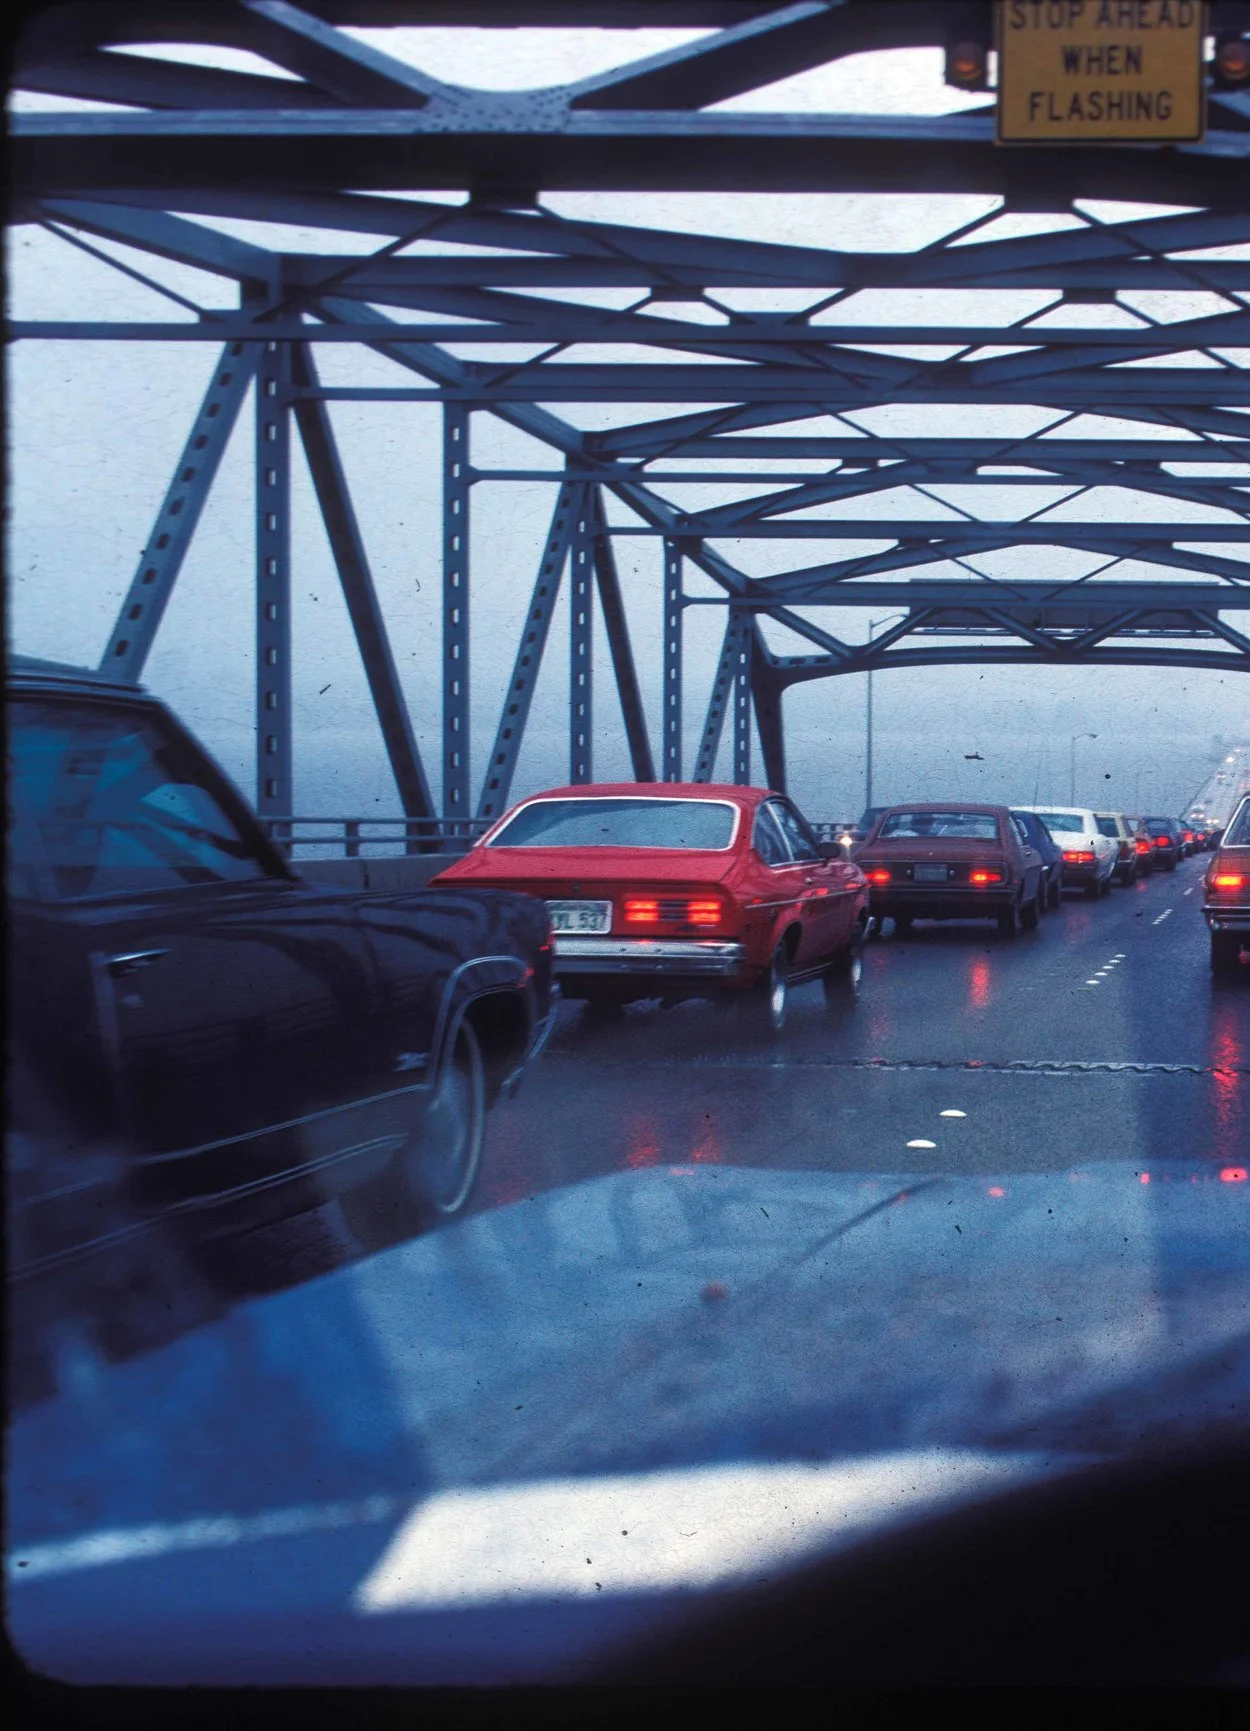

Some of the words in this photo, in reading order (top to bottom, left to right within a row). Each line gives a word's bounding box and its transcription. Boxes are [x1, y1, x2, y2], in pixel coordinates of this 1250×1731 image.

[1010, 0, 1085, 30] STOP
[1094, 0, 1195, 30] AHEAD
[1062, 45, 1142, 76] WHEN
[1028, 90, 1173, 121] FLASHING
